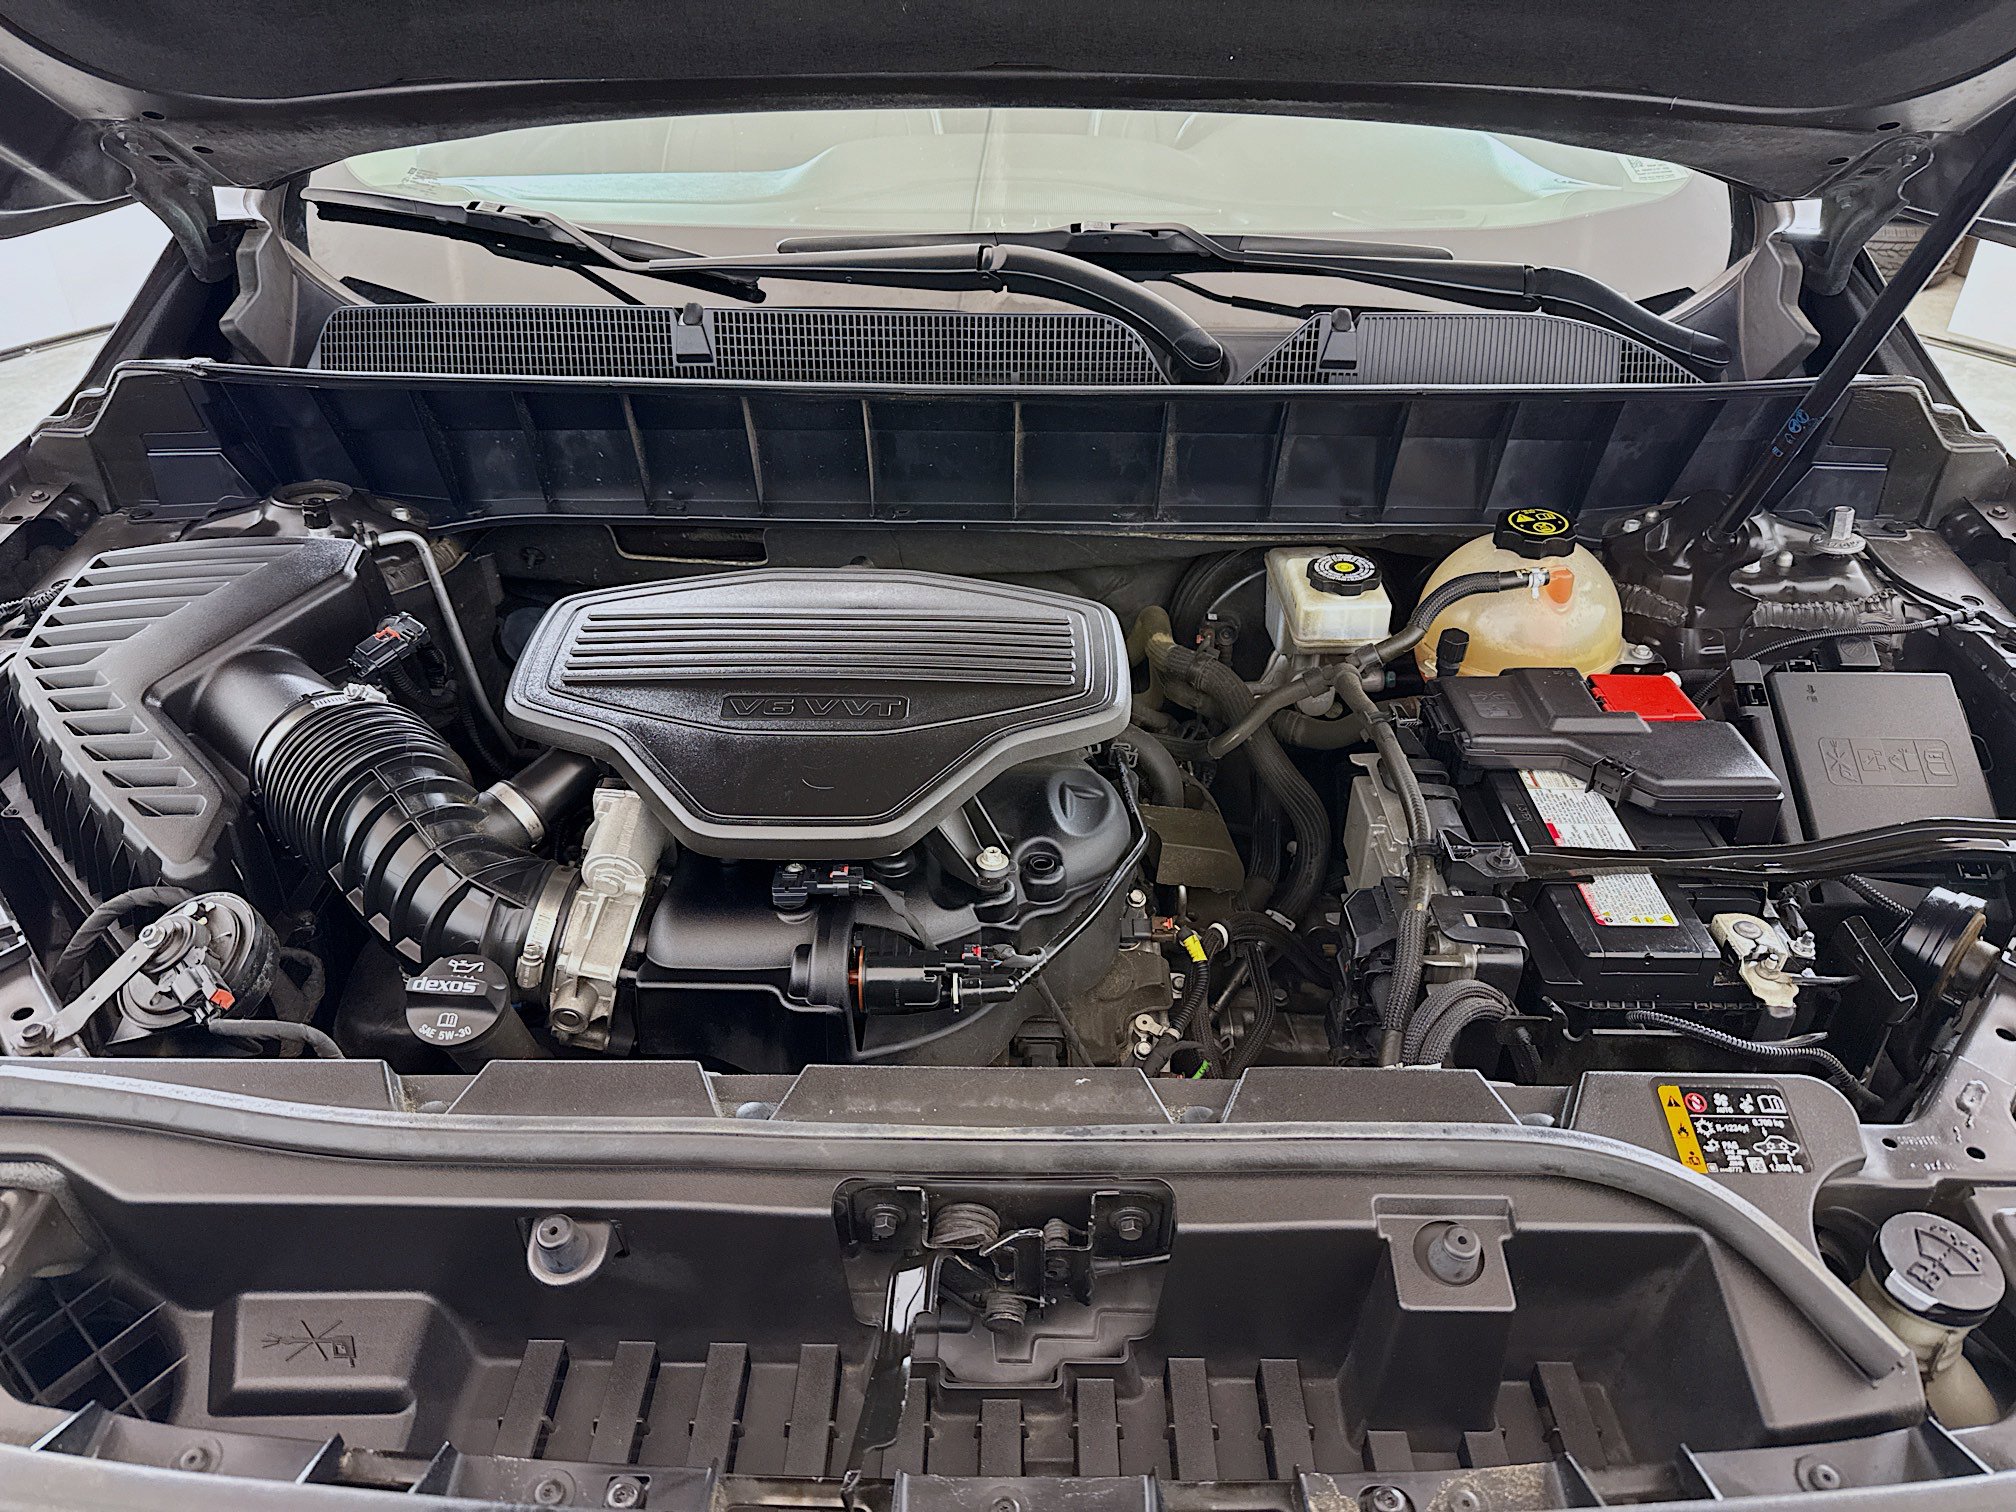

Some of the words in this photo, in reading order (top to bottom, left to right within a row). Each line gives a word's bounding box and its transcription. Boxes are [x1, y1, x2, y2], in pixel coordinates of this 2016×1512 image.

[729, 698, 795, 716] V6
[804, 698, 902, 717] VVT
[412, 976, 480, 994] dexos
[418, 1023, 437, 1039] SAE
[438, 1026, 472, 1041] 5W-30
